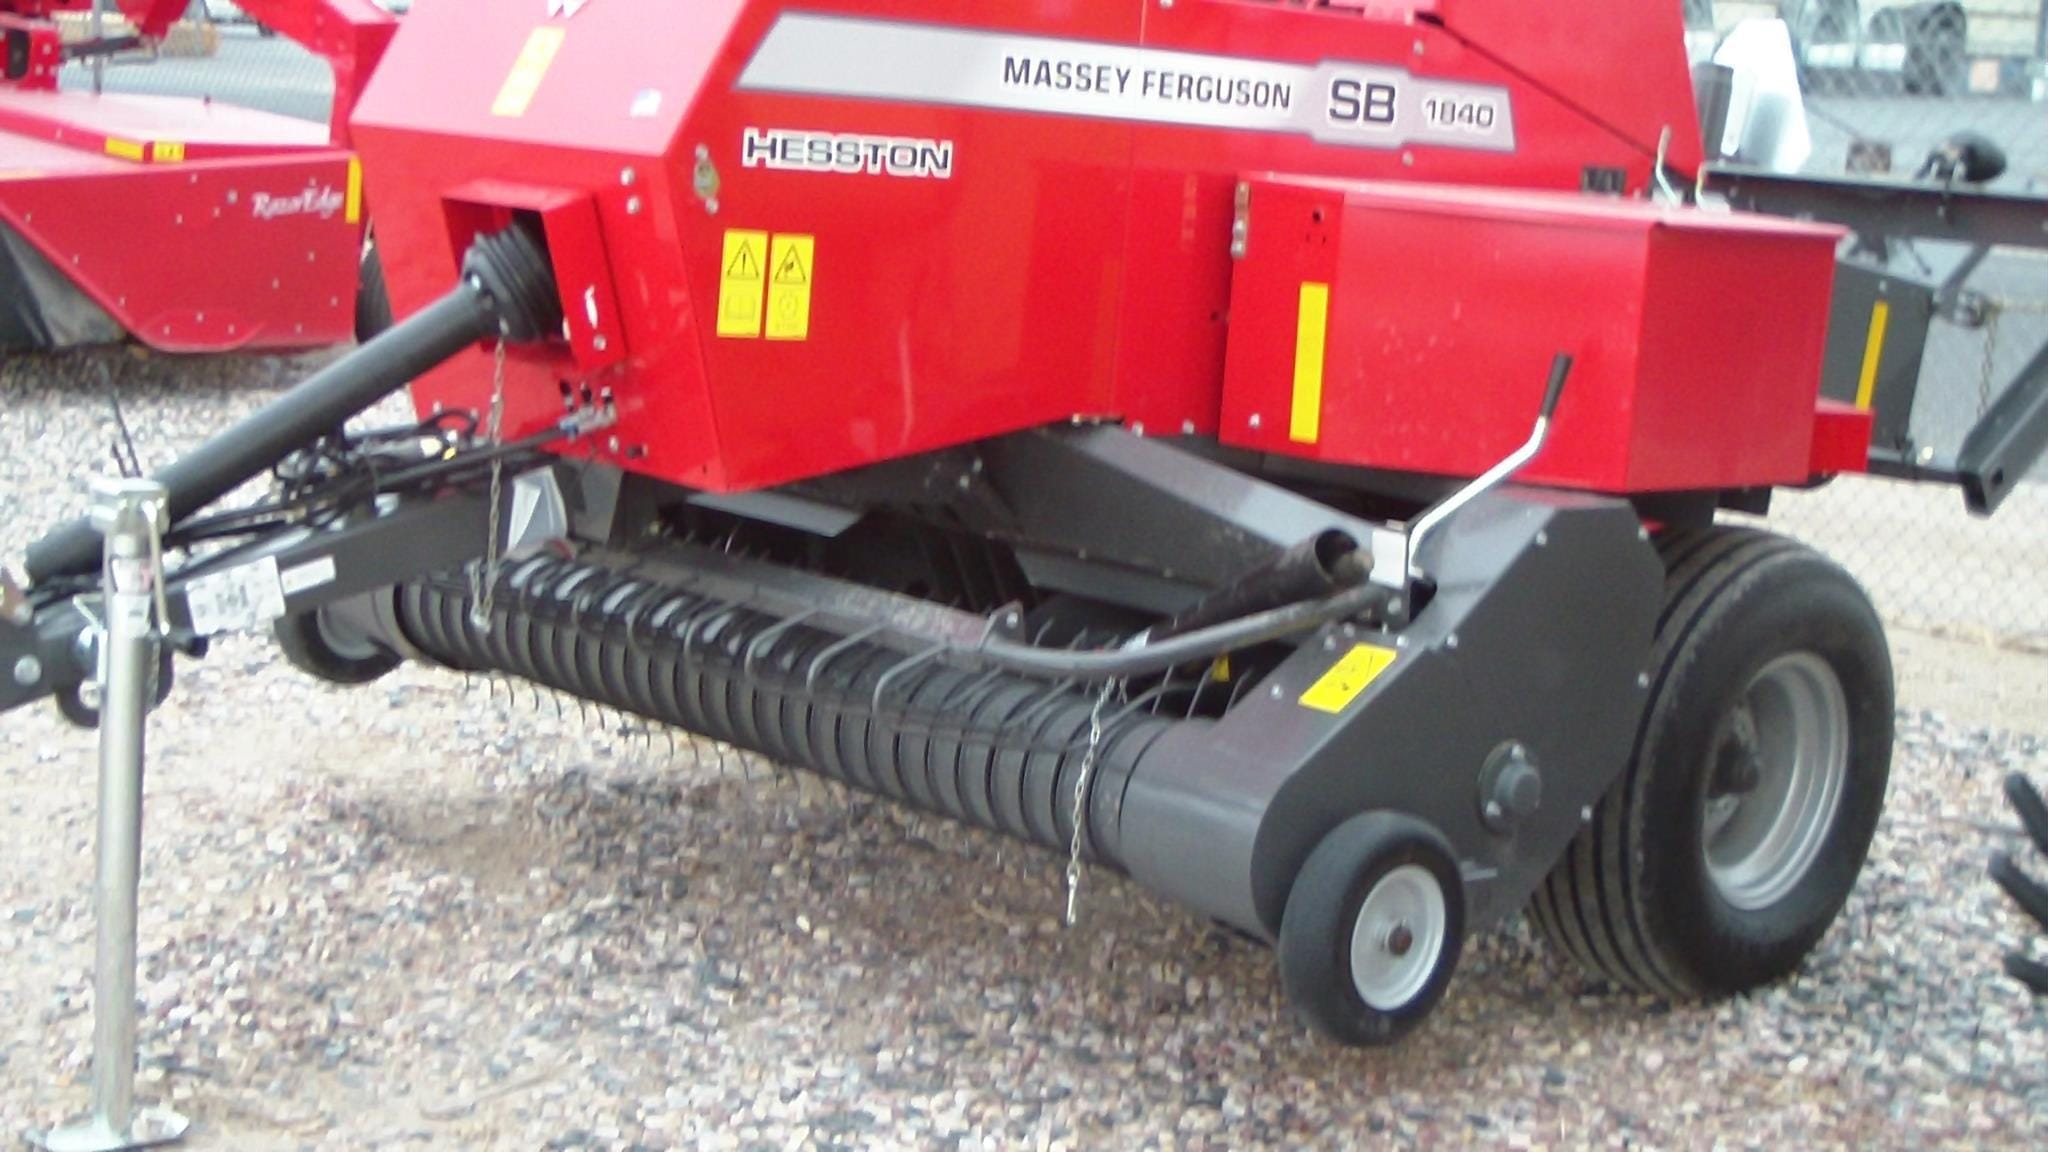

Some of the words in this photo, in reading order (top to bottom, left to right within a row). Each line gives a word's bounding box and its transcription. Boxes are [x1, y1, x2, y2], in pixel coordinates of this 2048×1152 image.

[1003, 56, 1130, 95] MASSEY
[1141, 69, 1292, 110] FERGUSON
[1329, 79, 1396, 124] SB
[1425, 97, 1495, 128] 1840
[742, 127, 953, 178] HESSTON
